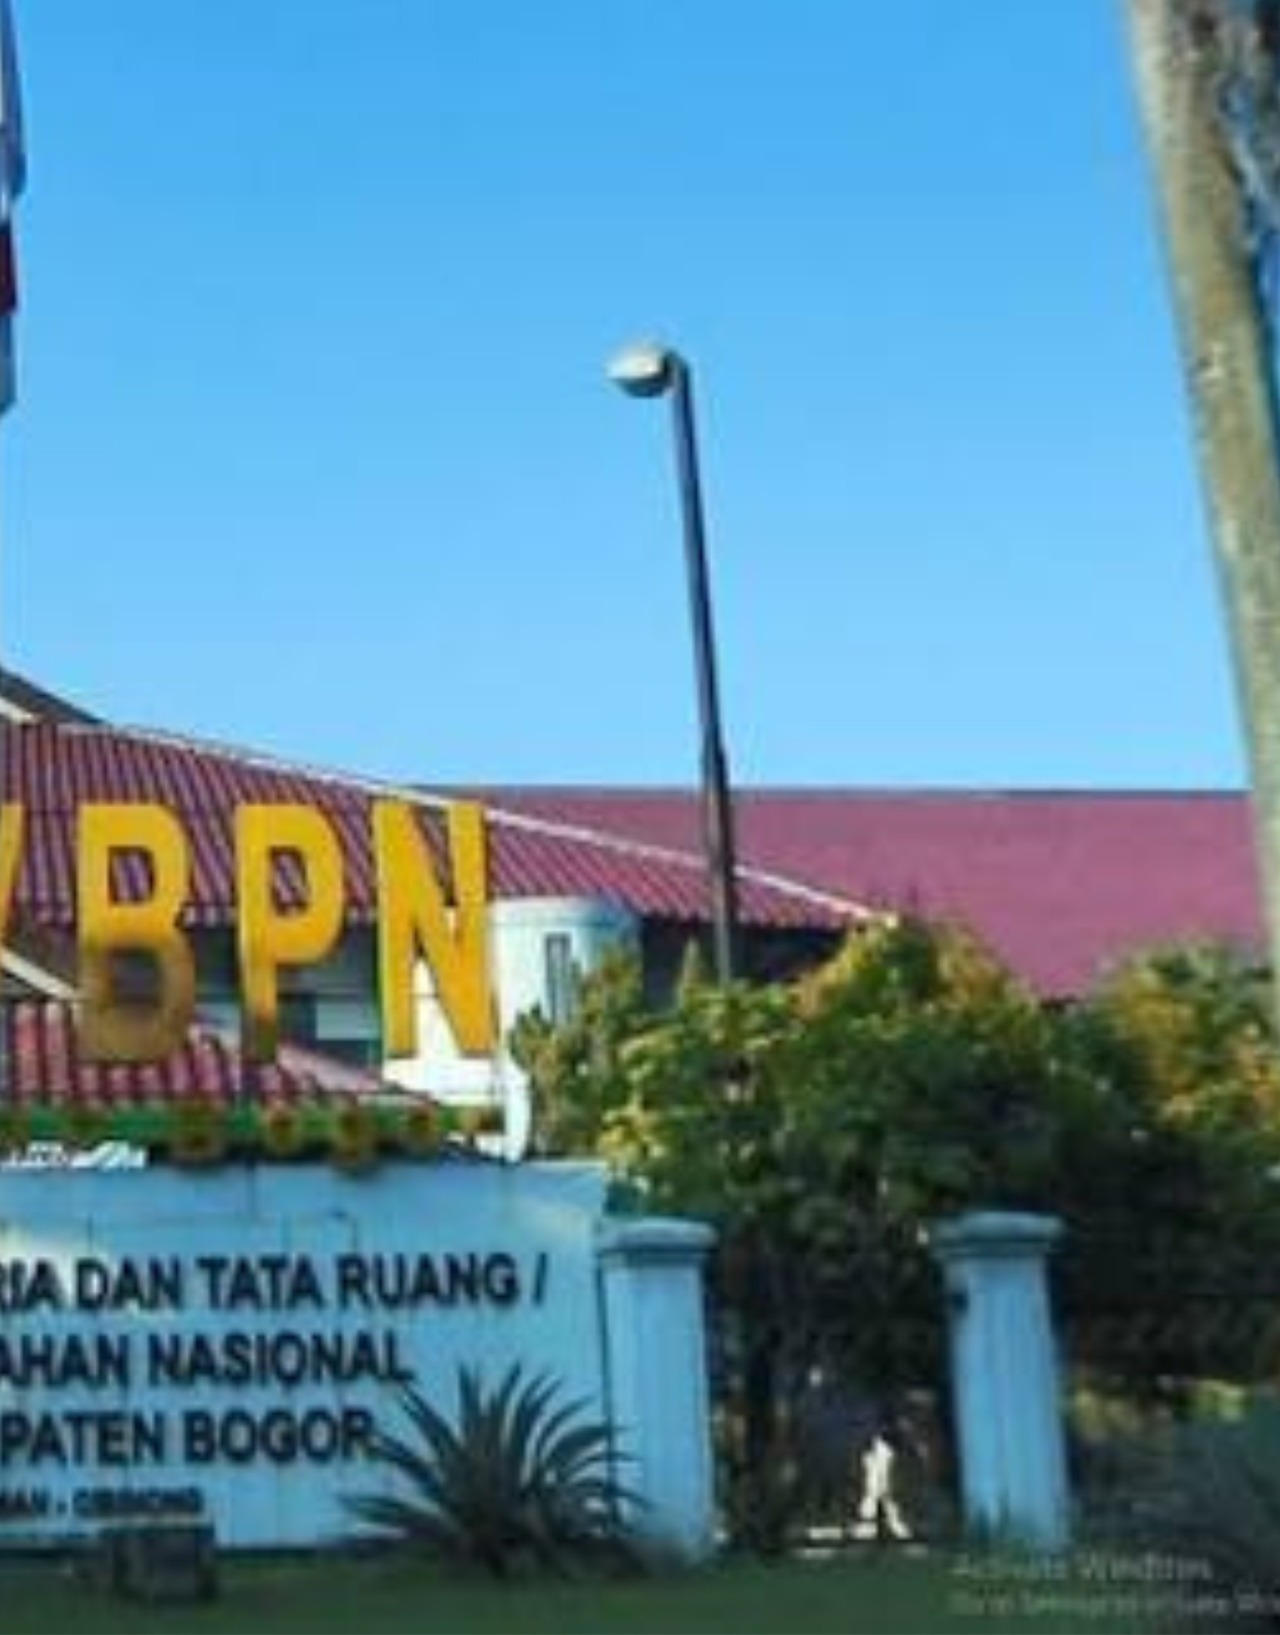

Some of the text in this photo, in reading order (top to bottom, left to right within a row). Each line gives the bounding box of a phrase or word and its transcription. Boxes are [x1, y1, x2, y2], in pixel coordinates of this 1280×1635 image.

[74, 1256, 182, 1312] DAN
[196, 1254, 324, 1310] TATA
[334, 1252, 519, 1308] RUANG
[530, 1252, 548, 1305] /
[148, 1330, 412, 1384] NASIONAL
[183, 1408, 376, 1464] BOGOR
